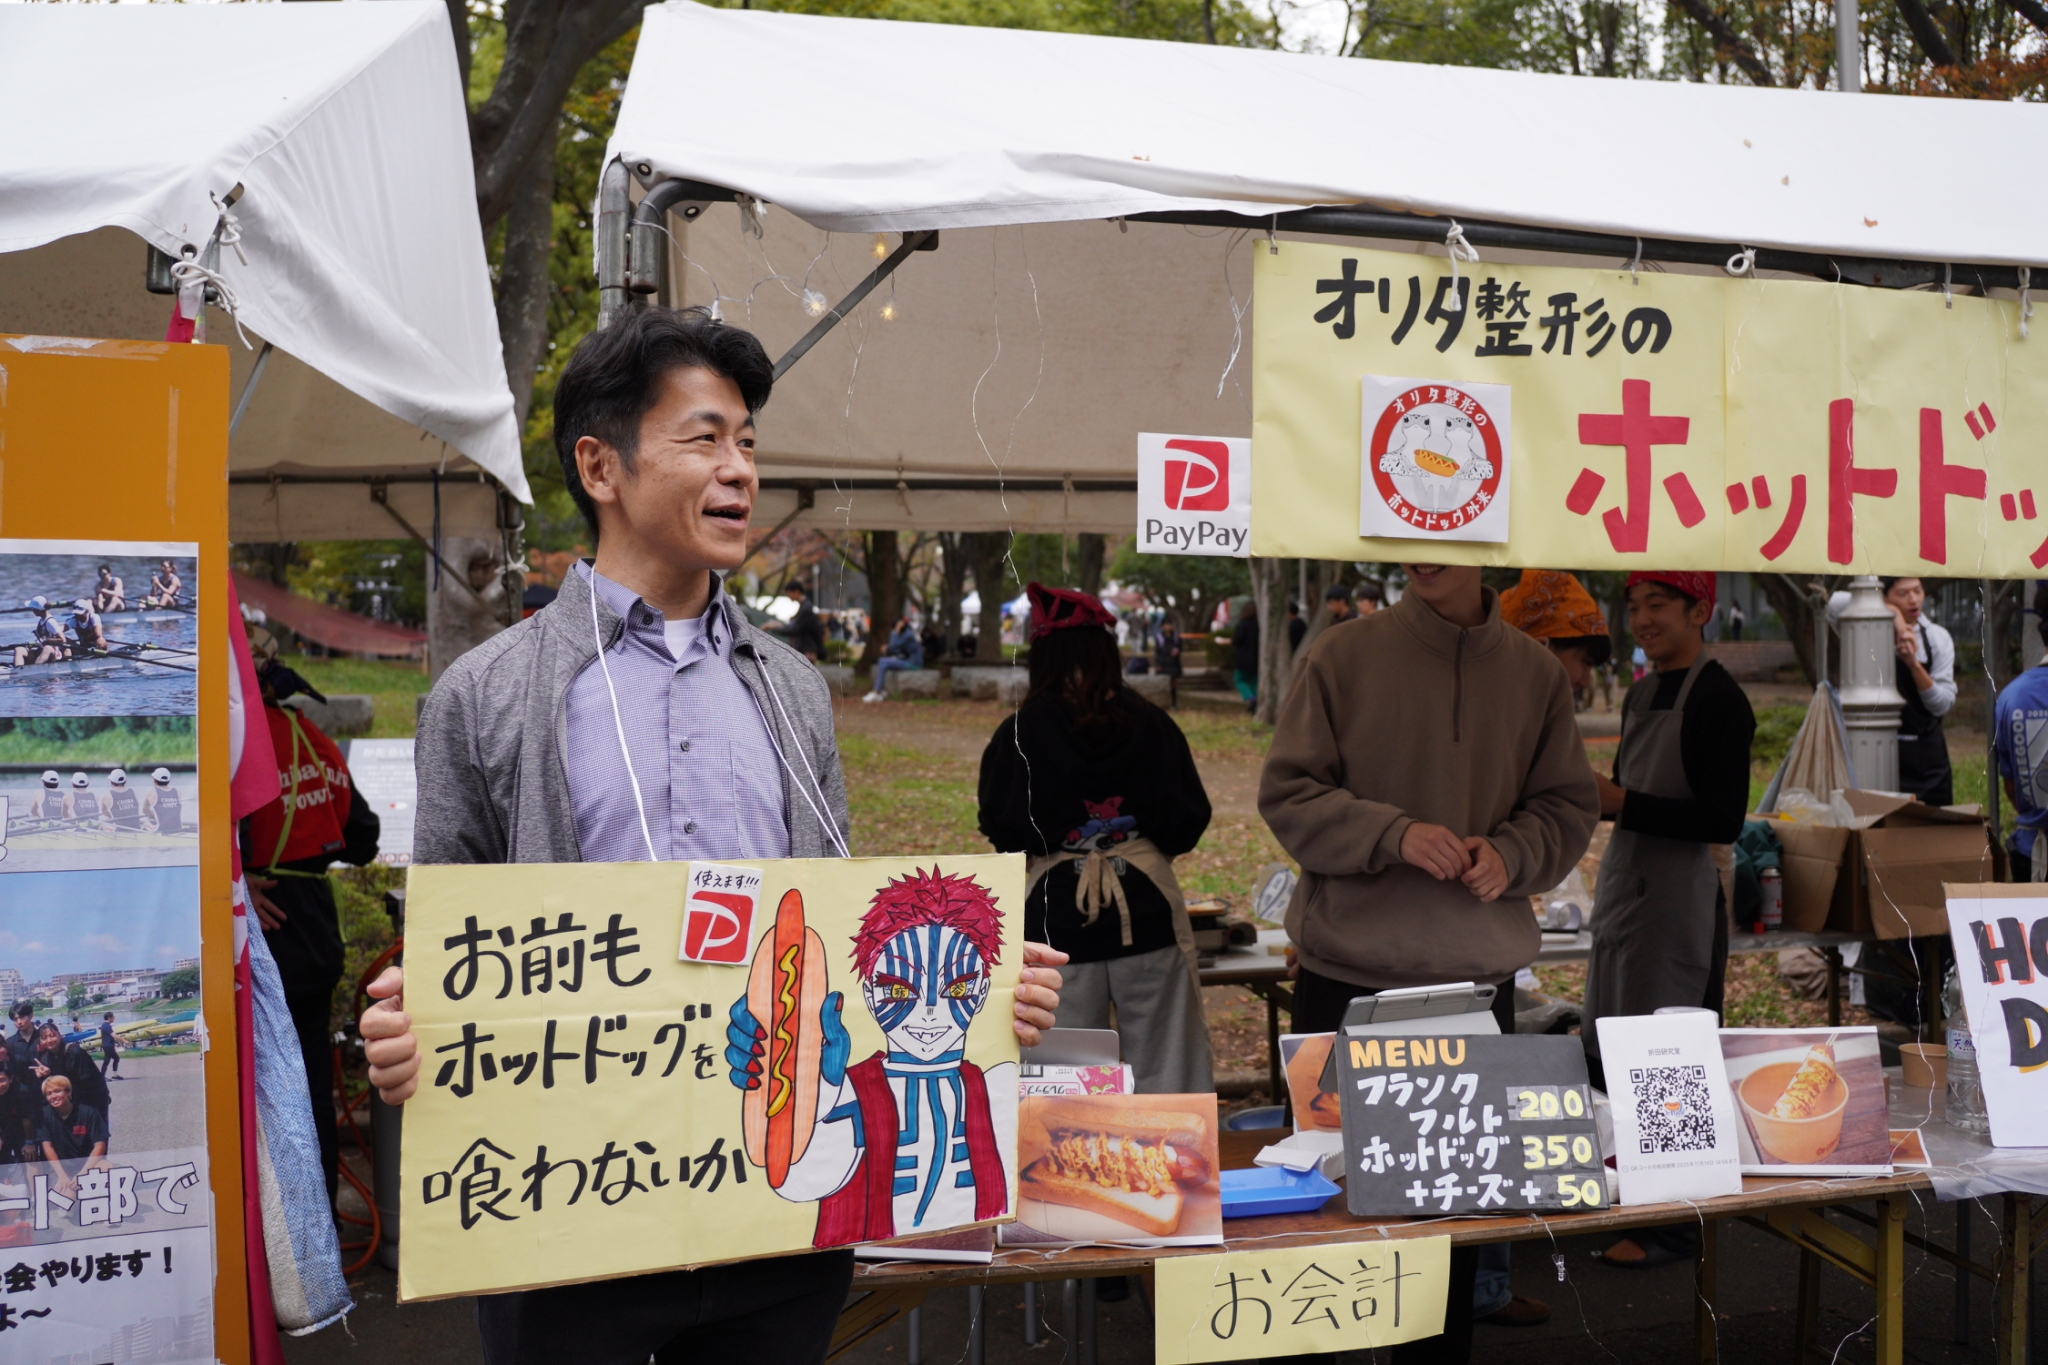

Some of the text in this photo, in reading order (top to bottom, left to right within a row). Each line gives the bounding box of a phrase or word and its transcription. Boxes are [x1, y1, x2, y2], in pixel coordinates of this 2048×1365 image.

[1314, 258, 1672, 357] オリタ整形の
[1393, 387, 1487, 426] オリタ整形の
[1388, 489, 1491, 530] ホットドッグ外来
[1146, 519, 1248, 552] PayPay
[442, 913, 651, 1000] お前も
[434, 1003, 719, 1099] ホットドッグを
[1350, 1038, 1466, 1069] MENU
[2000, 997, 2048, 1074] D
[1357, 1073, 1478, 1107] フランク
[1409, 1089, 1584, 1135] フルト 200
[1360, 1135, 1592, 1174] ホットドッグ 350
[422, 1137, 748, 1231] 喰わないか
[1557, 1175, 1601, 1207] 50
[0, 1247, 172, 1294] 会やります！
[1211, 1251, 1421, 1339] お会計
